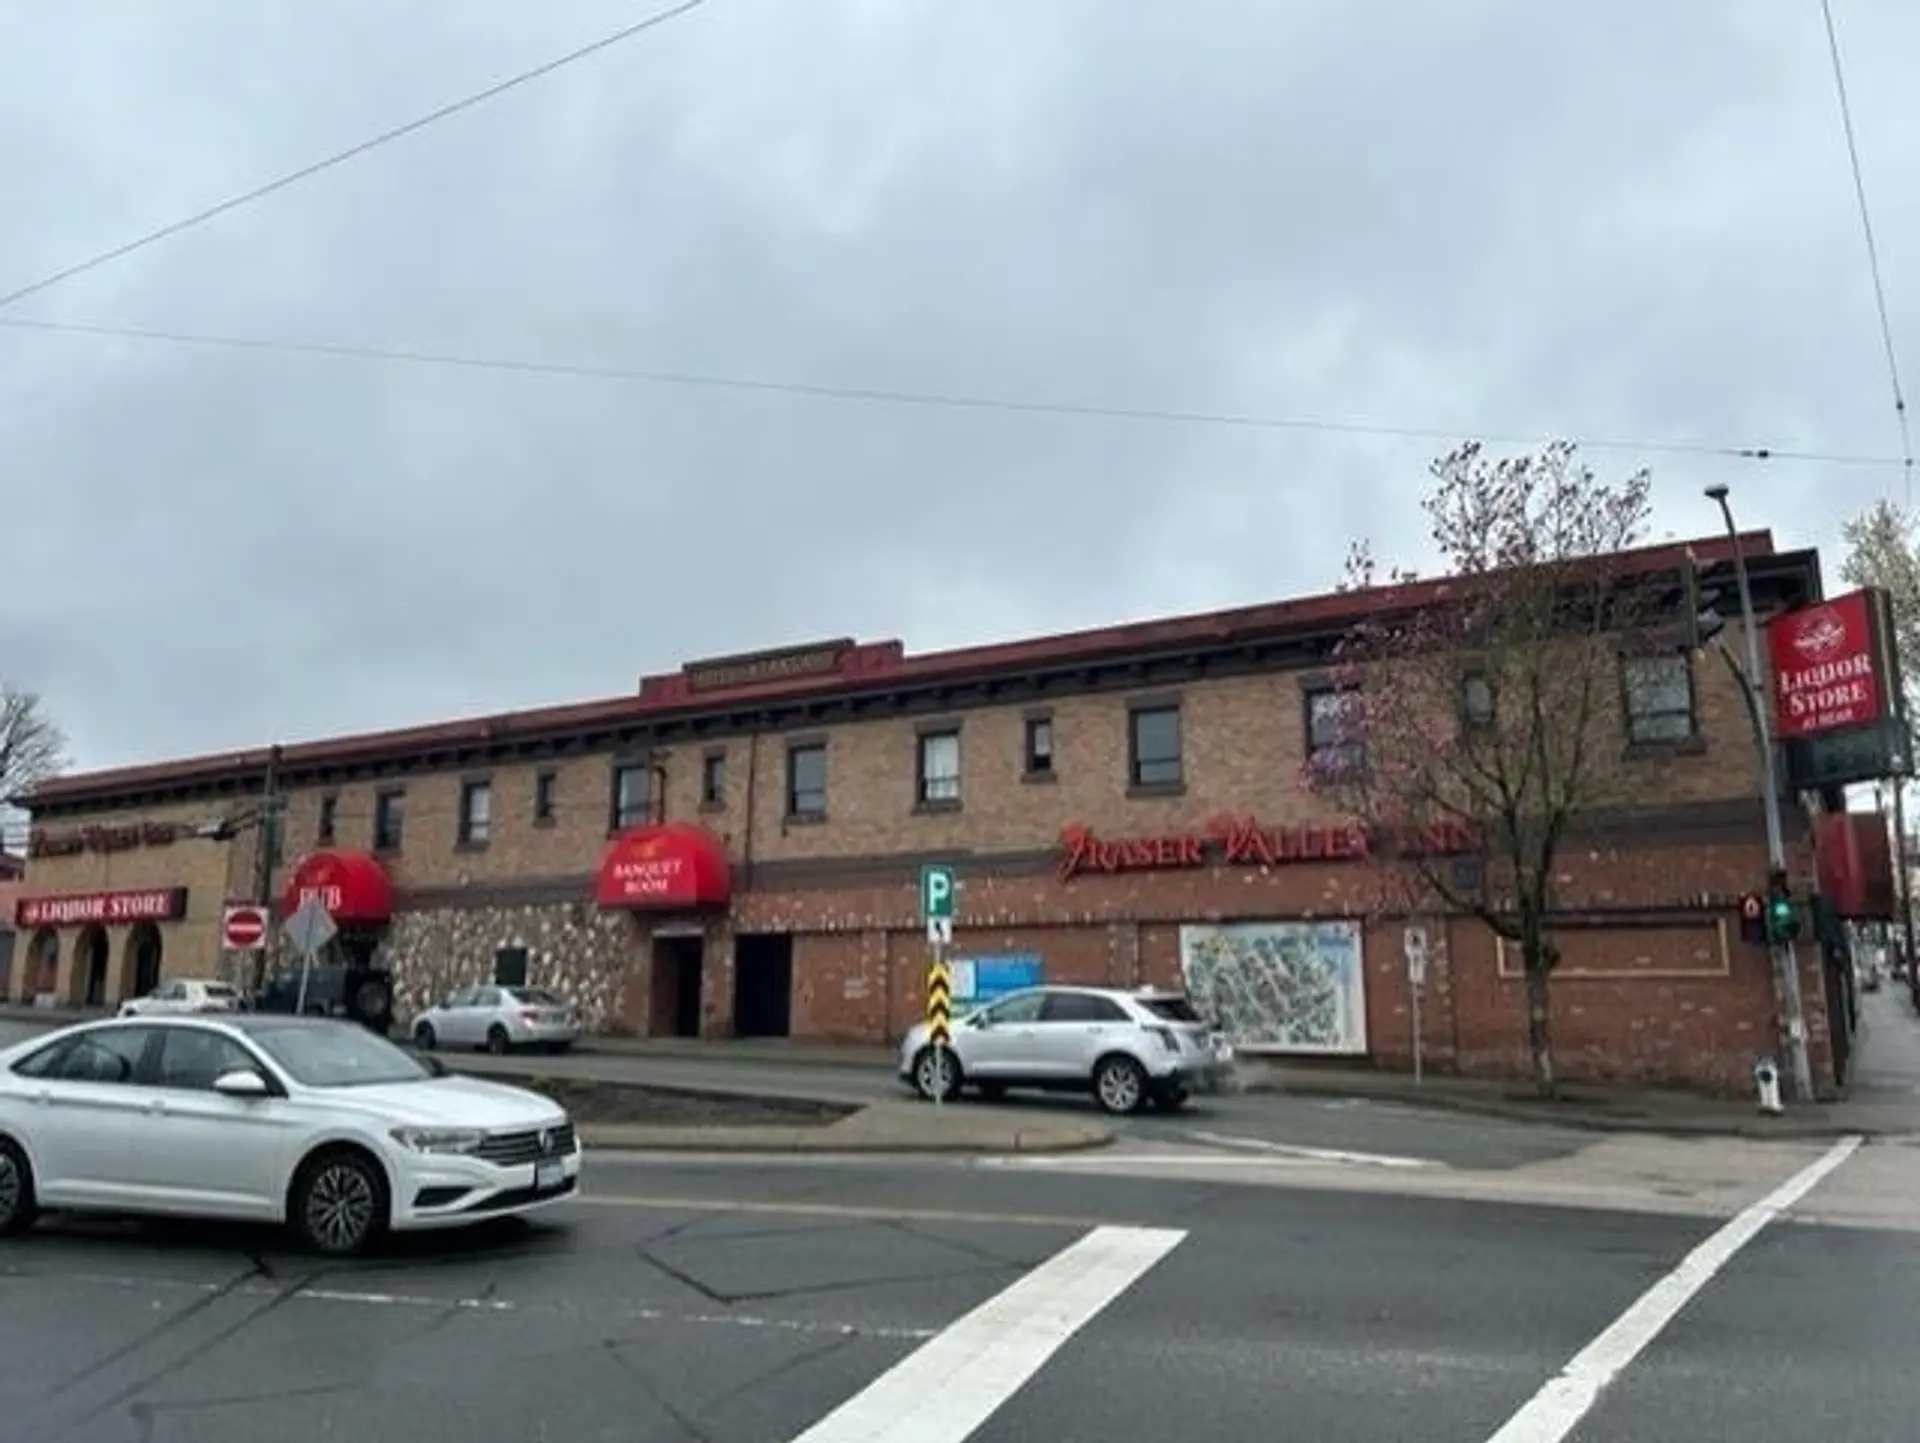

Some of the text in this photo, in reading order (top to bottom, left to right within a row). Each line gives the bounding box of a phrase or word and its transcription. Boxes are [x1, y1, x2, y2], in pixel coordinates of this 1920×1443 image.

[1780, 652, 1872, 696] LIQUOR
[1788, 679, 1868, 716] STORE
[1057, 820, 1202, 885] FRASER
[41, 893, 168, 922] LIQUOR STORE
[928, 871, 949, 914] P
